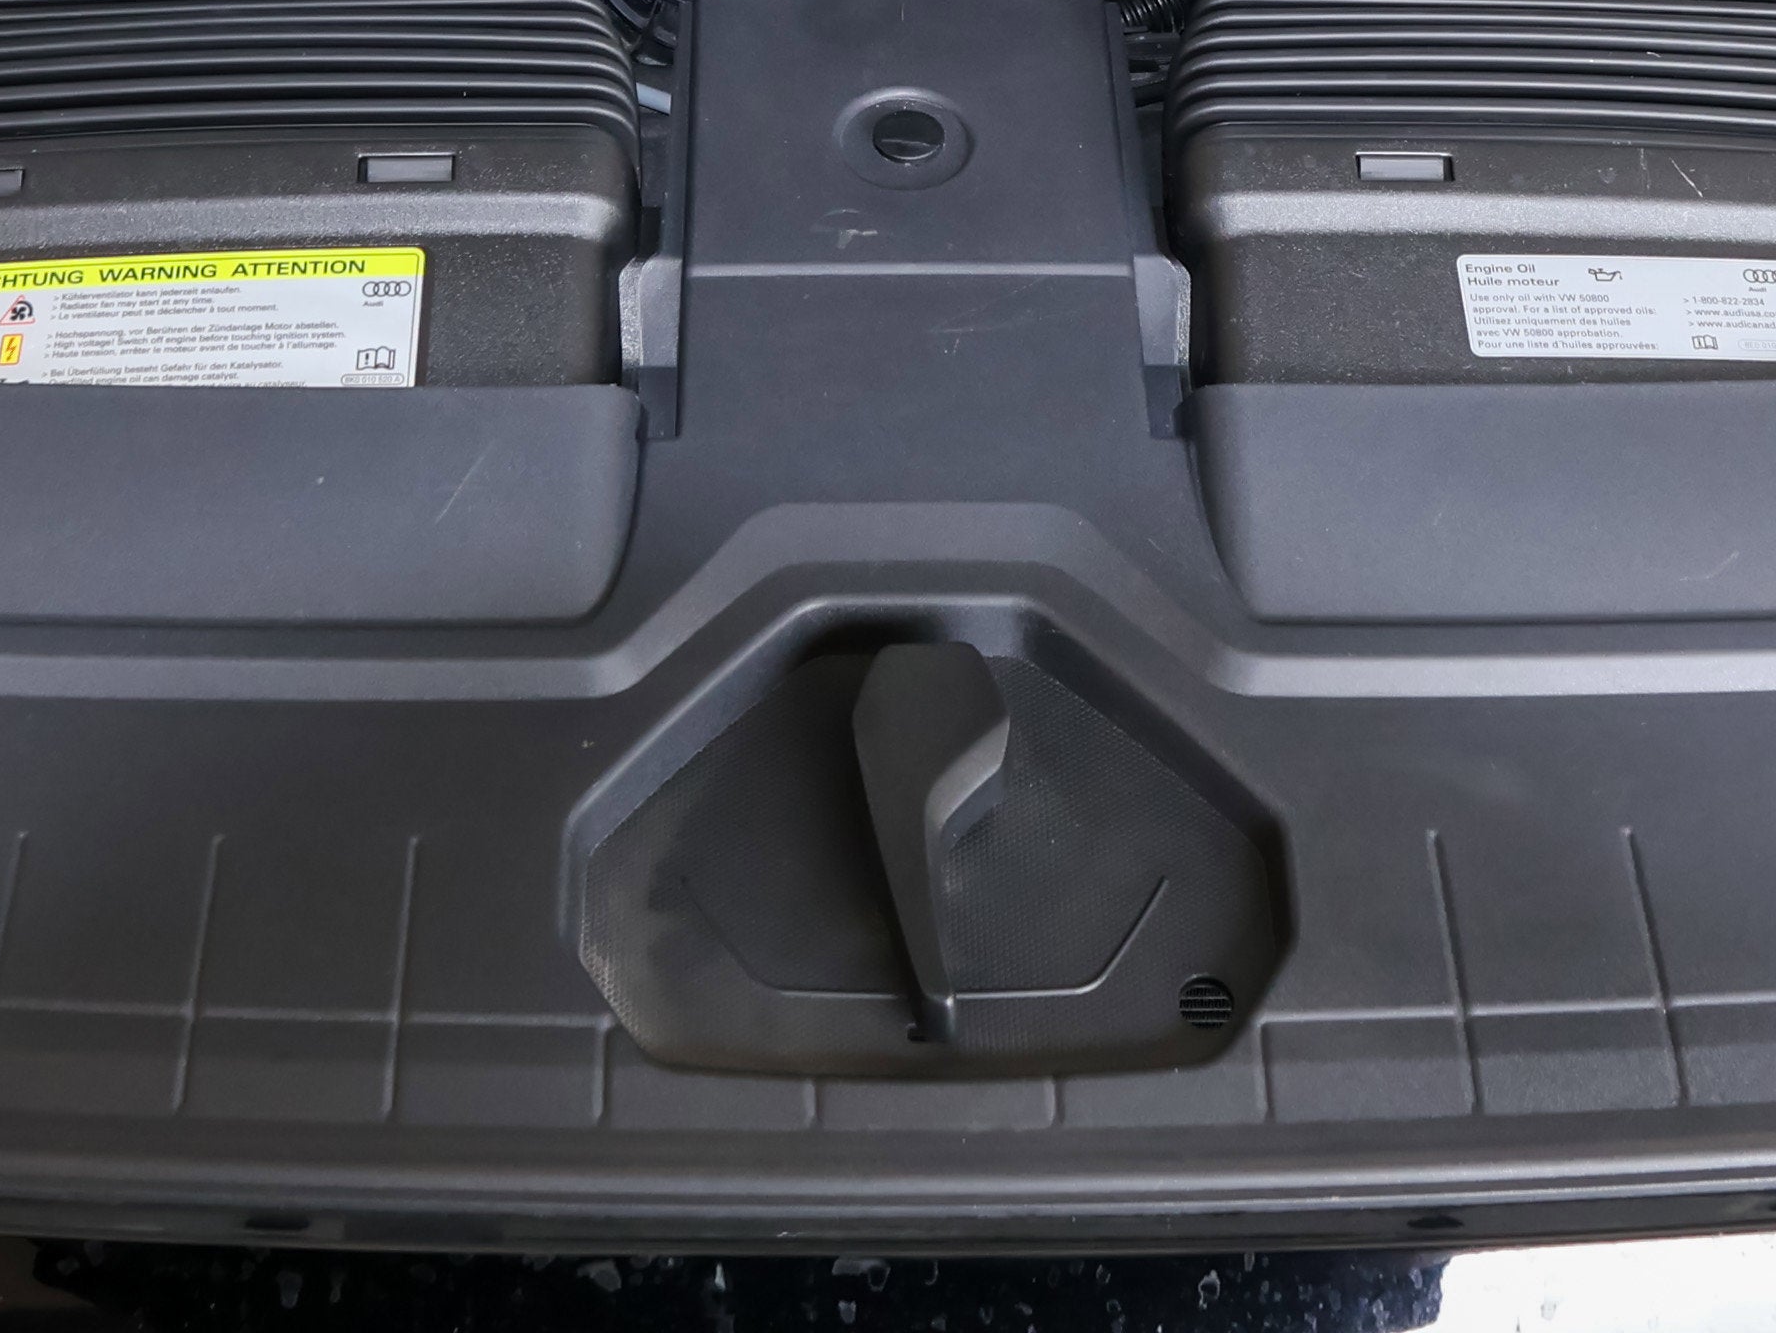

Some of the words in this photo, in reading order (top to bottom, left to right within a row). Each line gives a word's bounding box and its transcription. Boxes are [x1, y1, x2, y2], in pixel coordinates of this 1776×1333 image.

[99, 264, 218, 282] WARNING
[231, 260, 365, 276] ATTENTION
[1465, 263, 1512, 275] Engine
[1517, 263, 1535, 273] Oil
[1467, 277, 1503, 286] Huile
[1507, 278, 1560, 286] moteur
[61, 291, 133, 300] Kühlerventilator
[136, 289, 157, 297] kann
[160, 288, 198, 297] jederzeit
[200, 286, 241, 294] anlaufen.
[1470, 294, 1489, 302] Use
[1492, 294, 1514, 303] only
[1518, 294, 1530, 302] oil
[1534, 294, 1555, 302] with
[1558, 294, 1576, 302] VW
[1579, 294, 1609, 303] 50800
[59, 302, 98, 310] Radiator
[101, 300, 114, 308] fan
[117, 301, 136, 310] may
[139, 299, 159, 307] start
[174, 298, 189, 306] any
[1692, 296, 1765, 306] 1-800-822-2834
[58, 313, 69, 321] Le
[72, 310, 119, 320] ventilateur
[121, 310, 142, 318] peut
[157, 307, 206, 315] déclencher
[237, 304, 278, 312] moment.
[1524, 305, 1540, 313] For
[1552, 305, 1567, 313] list
[1571, 306, 1581, 314] of
[1584, 306, 1633, 315] approved
[1474, 316, 1511, 325] Utilisez
[1514, 317, 1576, 326] uniquement
[1579, 318, 1597, 326] des
[1600, 317, 1631, 326] huiles
[146, 326, 188, 334] Berühren
[209, 323, 262, 332] Zündanlage
[265, 322, 292, 330] Motor
[294, 321, 339, 330] abstellen.
[1476, 329, 1500, 337] avec
[1502, 328, 1520, 336] VW
[1524, 328, 1553, 337] 50800
[1557, 328, 1623, 338] approbation.
[54, 341, 75, 349] High
[117, 337, 148, 346] Switch
[165, 335, 196, 344] engine
[199, 333, 229, 341] before
[231, 332, 270, 341] touching
[273, 331, 309, 340] ignition
[311, 331, 345, 340] system.
[1478, 340, 1502, 348] Pour
[1527, 340, 1549, 349] liste
[52, 350, 78, 359] Haute
[120, 345, 151, 354] arrêter
[199, 343, 224, 351] avant
[226, 343, 239, 351] de
[241, 342, 275, 350] toucher
[50, 369, 65, 377] Bei
[67, 365, 122, 376] Überfüllung
[125, 365, 158, 373] besteht
[160, 363, 192, 372] Gefahr
[194, 362, 207, 371] für
[209, 362, 227, 370] den
[229, 361, 283, 370] Katalysator.
[95, 375, 127, 384] engine
[161, 373, 199, 382] damage
